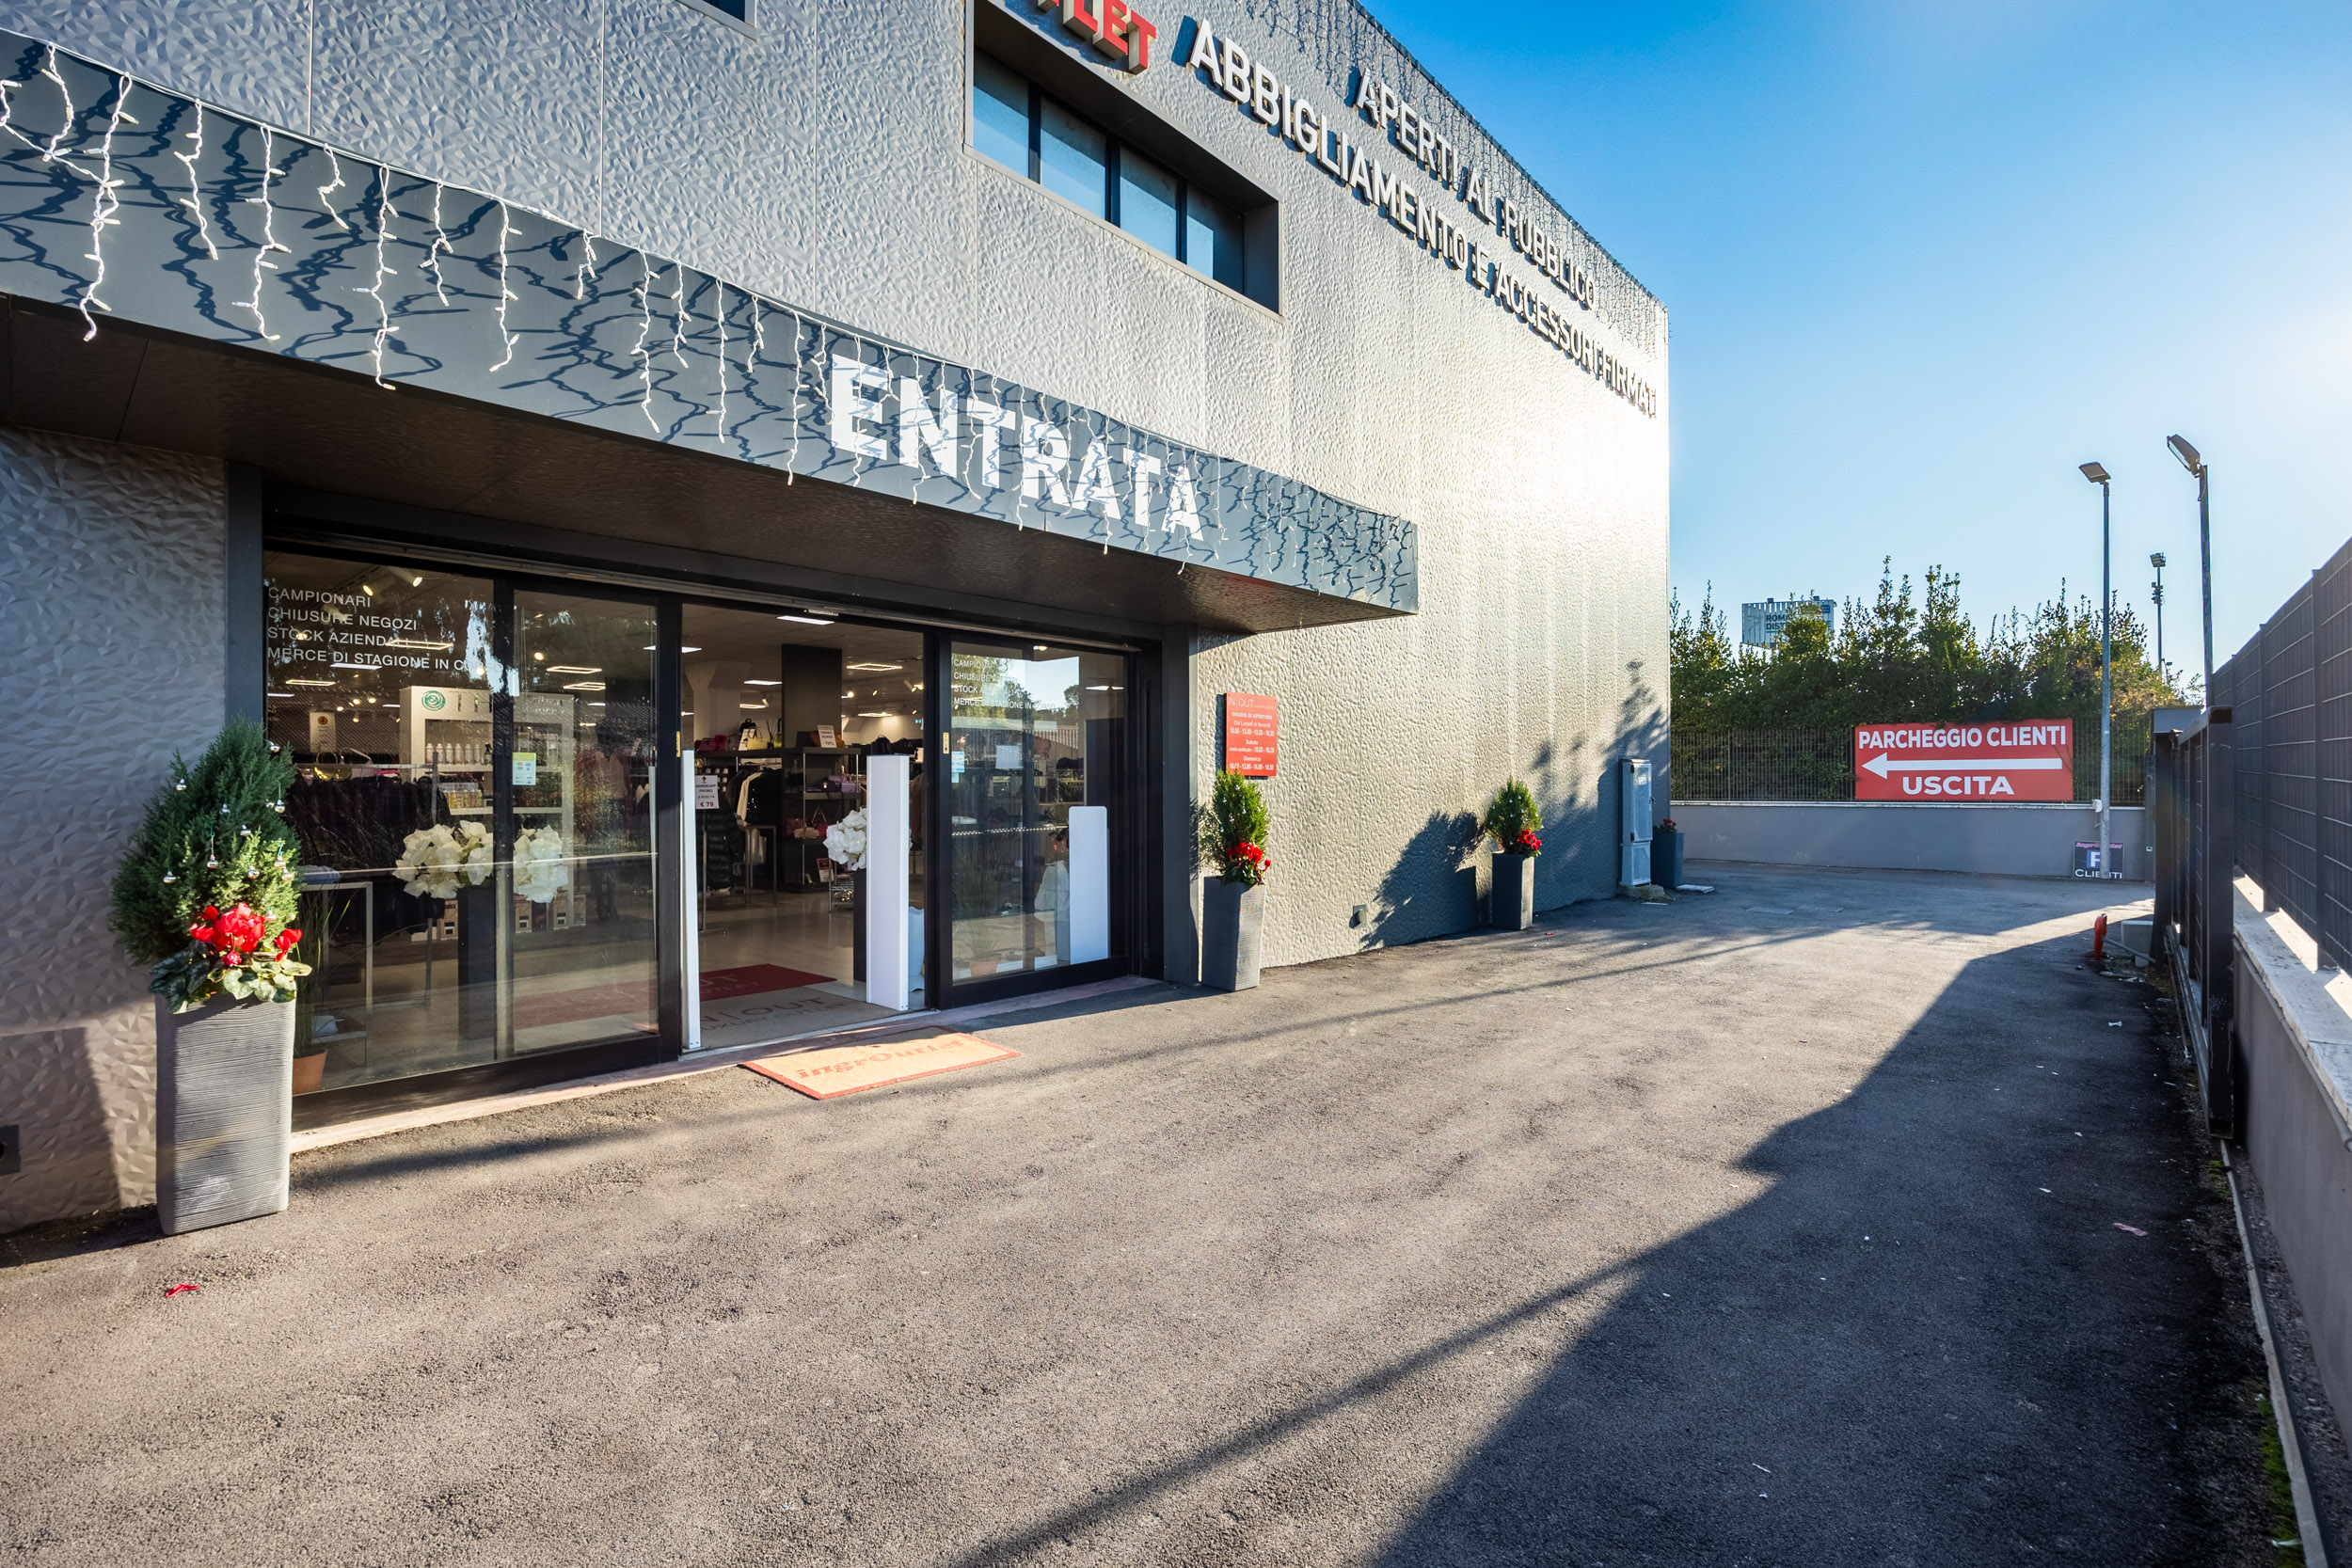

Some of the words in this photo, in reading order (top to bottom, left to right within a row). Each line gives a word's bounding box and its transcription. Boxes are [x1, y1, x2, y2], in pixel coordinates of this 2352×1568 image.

[1356, 67, 1458, 191] APERTI
[1467, 167, 1497, 226] AL
[1504, 198, 1597, 310] PUBBLICO
[1189, 18, 1469, 270] ABBIGLIAMENTO
[1475, 242, 1489, 291] E
[1494, 261, 1600, 381] ACCESSORI
[1601, 347, 1657, 419] FIRMATI
[831, 353, 1204, 542] ENTRATA
[268, 587, 371, 608] CAMPIONARI
[268, 607, 354, 625] CHIUSURE
[359, 615, 417, 630] NEGOZI
[267, 626, 324, 641] STOCK
[267, 647, 326, 662] MERCE
[333, 652, 348, 663] DI
[355, 653, 430, 669] STAGIONE
[435, 658, 449, 669] IN
[953, 658, 997, 670] CAMPIONAR
[953, 685, 978, 693] STOCK
[1025, 701, 1032, 709] IN
[1238, 699, 1254, 708] OUT
[1858, 727, 1982, 750] PARCHEGGIO
[1986, 725, 2066, 747] CLIENTI
[1902, 776, 2015, 796] USCITA
[2074, 869, 2122, 879] CLIETI
[700, 1016, 768, 1032] UXURY
